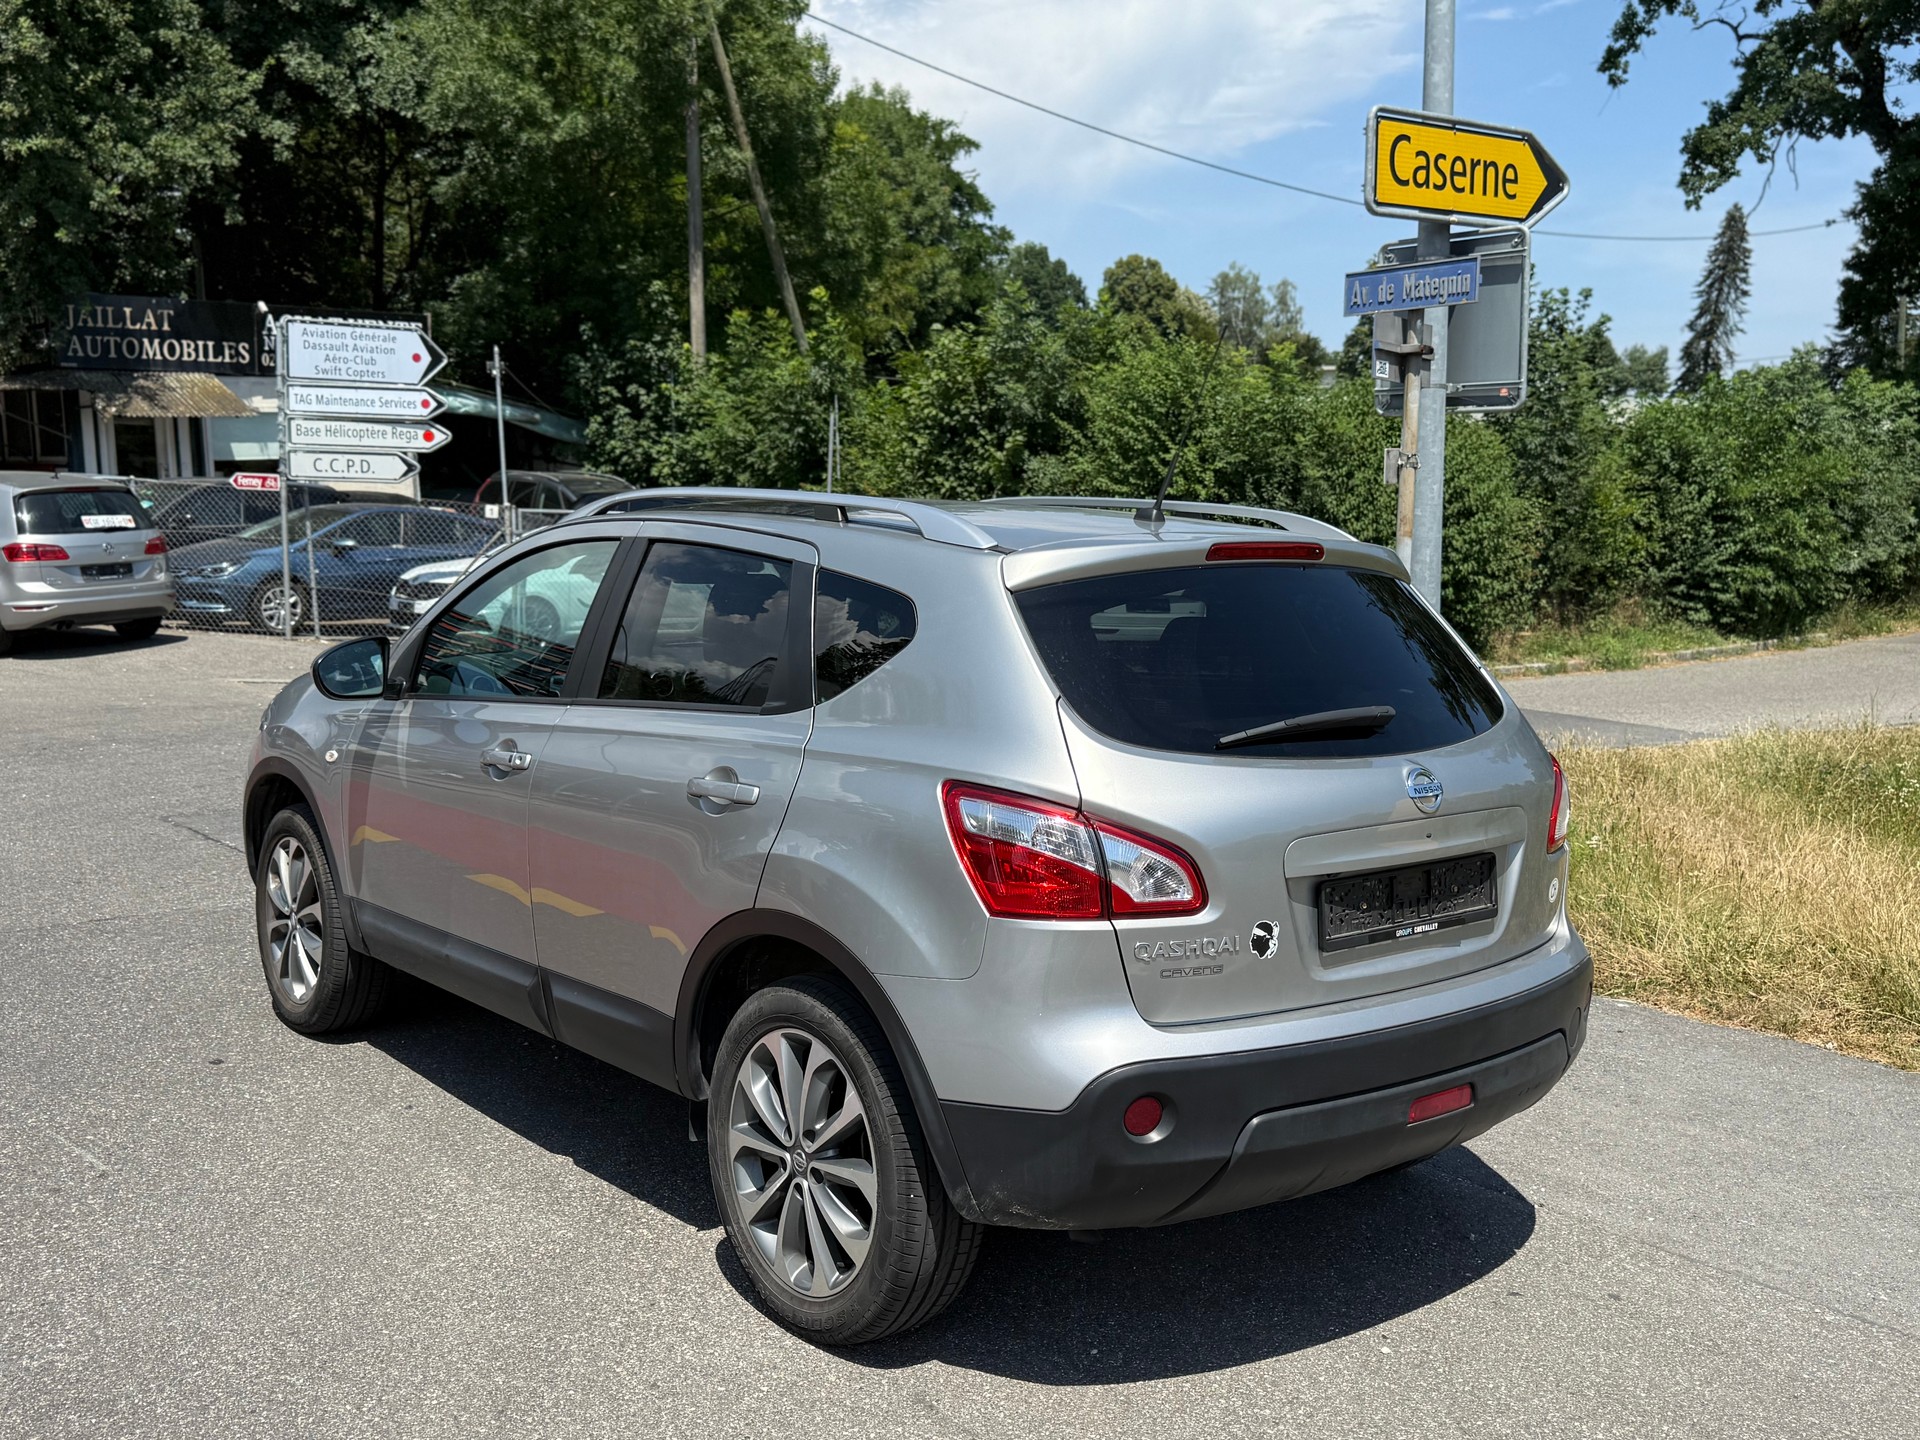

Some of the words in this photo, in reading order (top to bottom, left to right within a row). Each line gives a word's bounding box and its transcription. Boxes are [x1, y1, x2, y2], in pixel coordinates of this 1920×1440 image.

[1389, 134, 1519, 200] Caserne
[1350, 280, 1373, 308] Av.
[1377, 276, 1395, 305] de
[1402, 269, 1471, 304] Mategnin
[66, 304, 174, 331] JAILLAT
[301, 327, 347, 340] Aviation
[350, 329, 397, 344] Générale
[67, 334, 251, 364] AUTOMOBILES
[303, 339, 350, 353] Dassault
[352, 343, 396, 356] Aviation
[324, 352, 377, 366] Aéro-Club
[314, 365, 342, 377] Swift
[345, 367, 386, 380] Copters
[293, 393, 313, 406] TAG
[315, 394, 376, 408] Maintenance
[379, 396, 417, 410] Services
[295, 423, 322, 438] Base
[324, 423, 388, 442] Hélicoptère
[391, 427, 419, 444] Rega
[313, 457, 376, 474] C.C.P.D.
[237, 476, 263, 489] Ferney
[1413, 784, 1443, 795] NISSAN
[1134, 935, 1240, 963] QASHQAI
